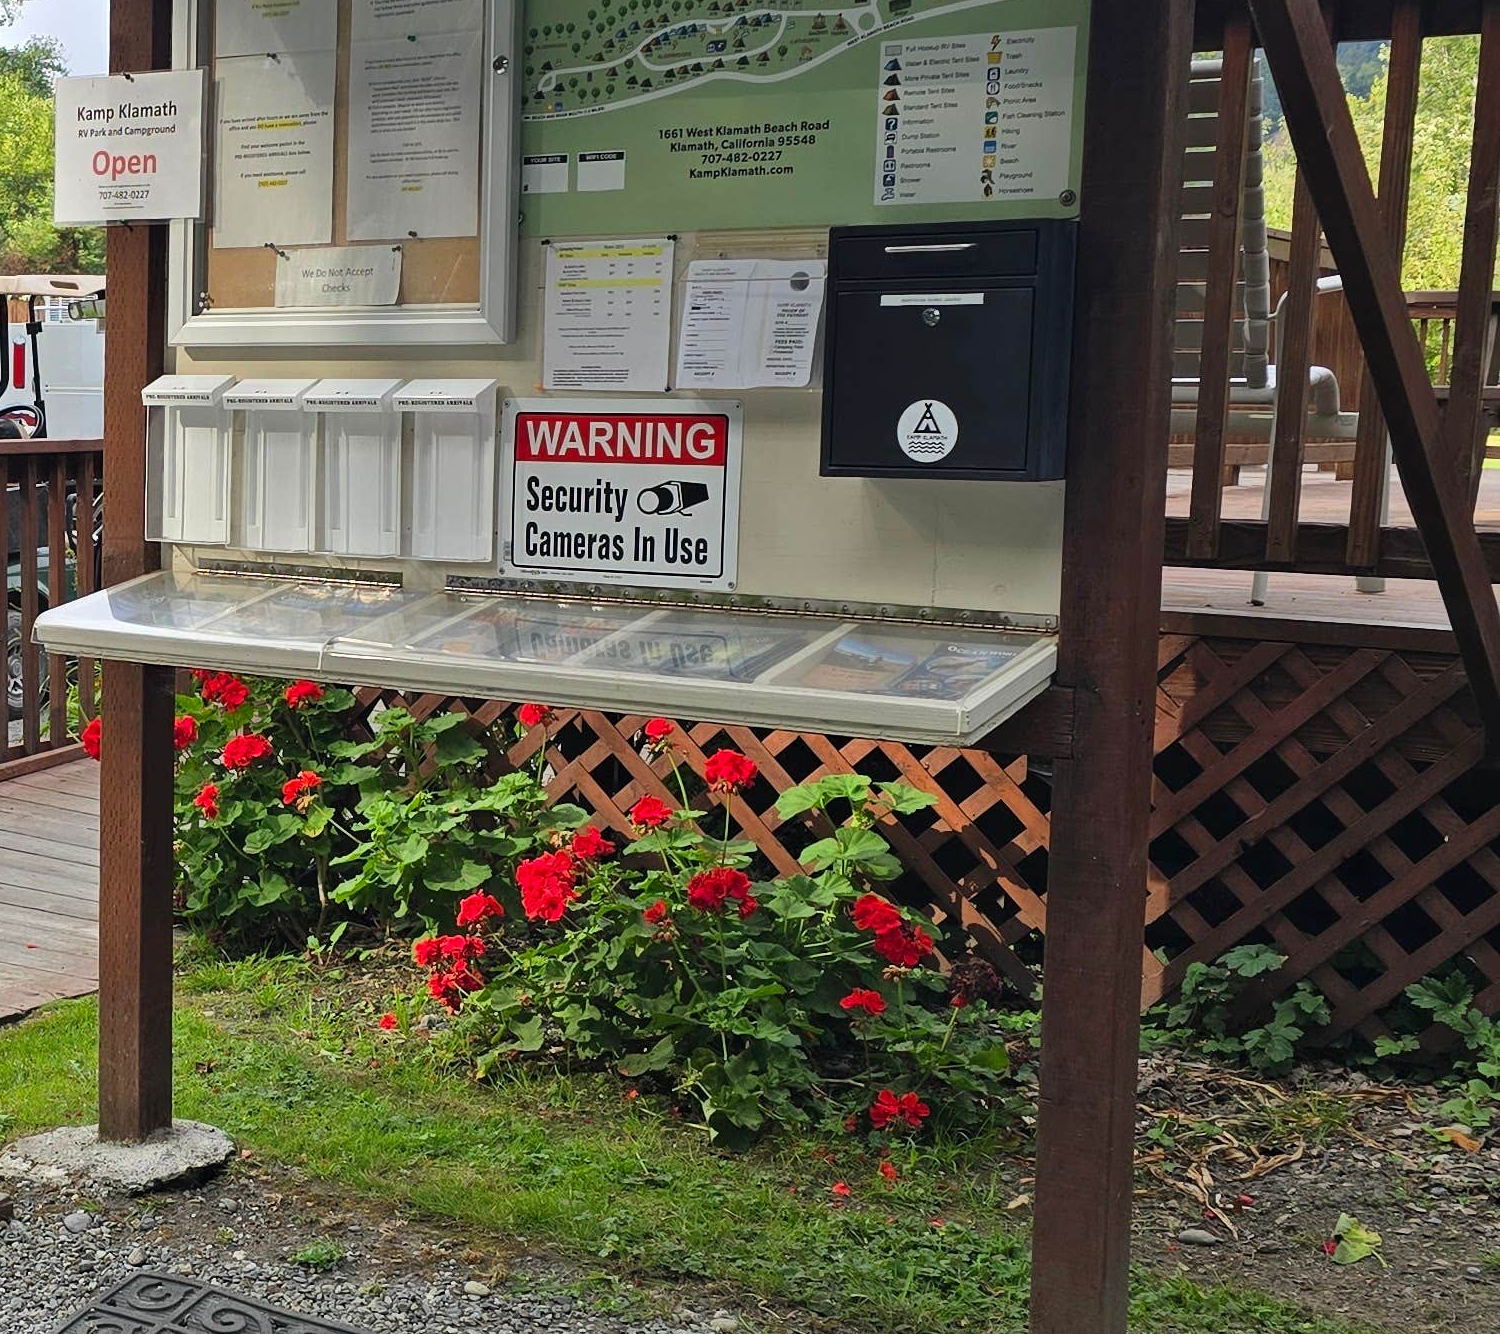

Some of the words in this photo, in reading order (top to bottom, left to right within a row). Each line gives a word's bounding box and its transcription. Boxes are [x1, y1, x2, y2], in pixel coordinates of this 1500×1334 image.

[77, 107, 115, 123] Kamp
[119, 101, 177, 119] Klamath
[78, 129, 88, 138] RV
[90, 128, 106, 137] Park
[108, 127, 123, 136] and
[125, 124, 176, 137] Campground
[659, 128, 684, 140] 1661
[686, 127, 714, 139] West
[716, 123, 762, 137] Klamath
[764, 122, 798, 134] Beach
[800, 119, 830, 132] Road
[671, 139, 719, 153] Klamath,
[721, 136, 774, 150] California
[777, 134, 816, 146] 95548
[92, 150, 157, 181] Open
[701, 150, 782, 164] 707-482-0227
[689, 164, 794, 180] KampKlamath.com
[99, 190, 150, 200] 707-482-0227
[301, 268, 315, 278] We
[316, 268, 326, 277] Do
[327, 267, 344, 277] Not
[346, 267, 374, 279] Accept
[322, 282, 350, 293] Checks
[525, 420, 716, 460] WARNING
[526, 475, 628, 523] Security
[525, 521, 624, 563] Cameras
[633, 526, 657, 562] In
[664, 528, 709, 565] Use
